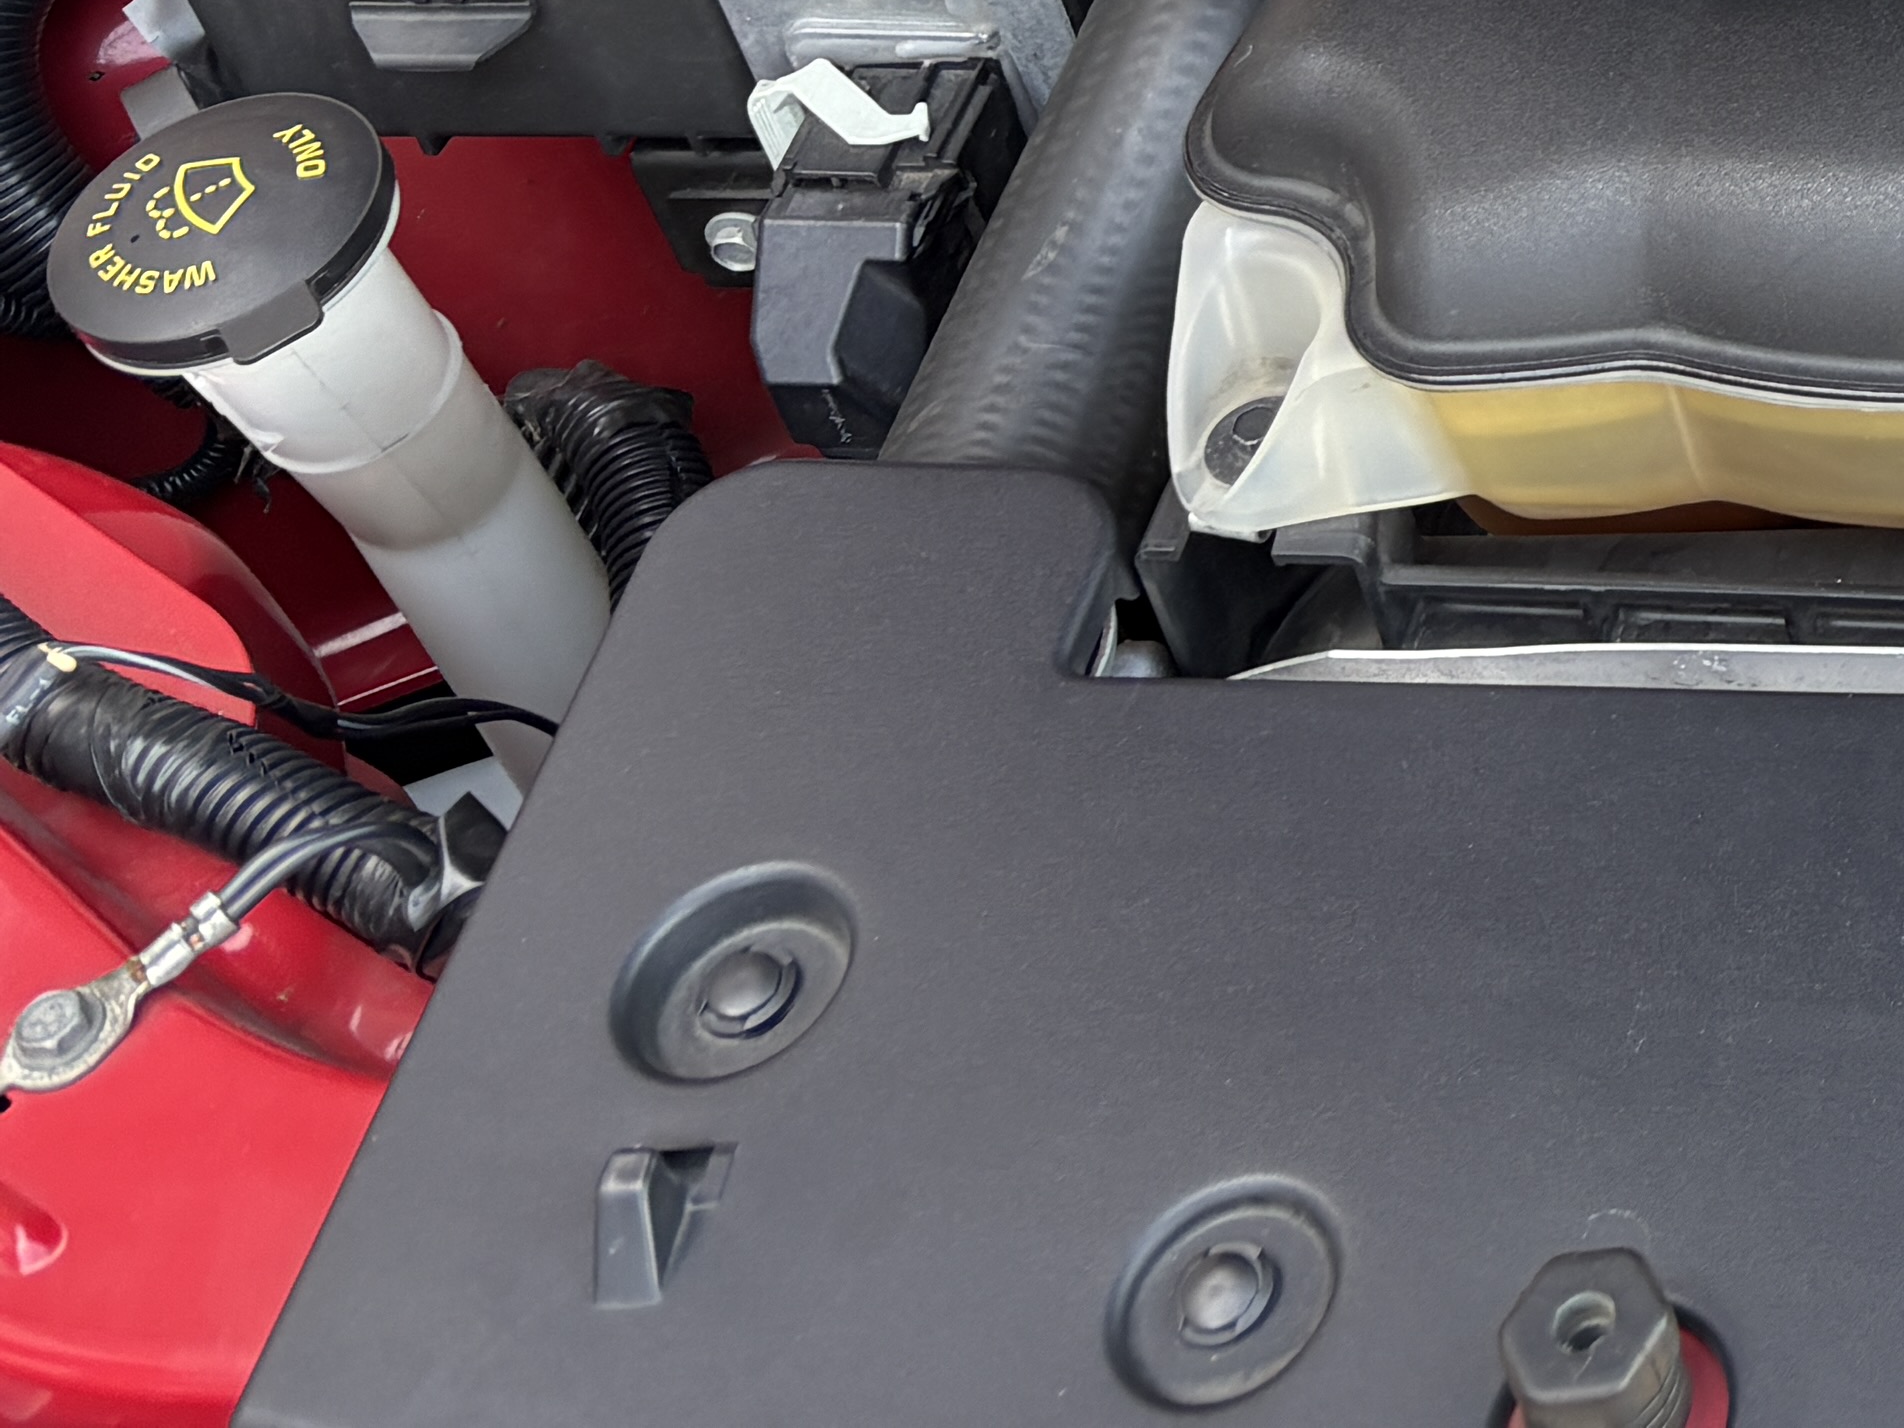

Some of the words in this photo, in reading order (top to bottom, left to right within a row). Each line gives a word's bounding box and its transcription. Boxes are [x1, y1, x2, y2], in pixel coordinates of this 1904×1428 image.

[272, 123, 327, 180] ONLY
[86, 152, 161, 238] FLUID
[88, 243, 217, 295] WASHER
